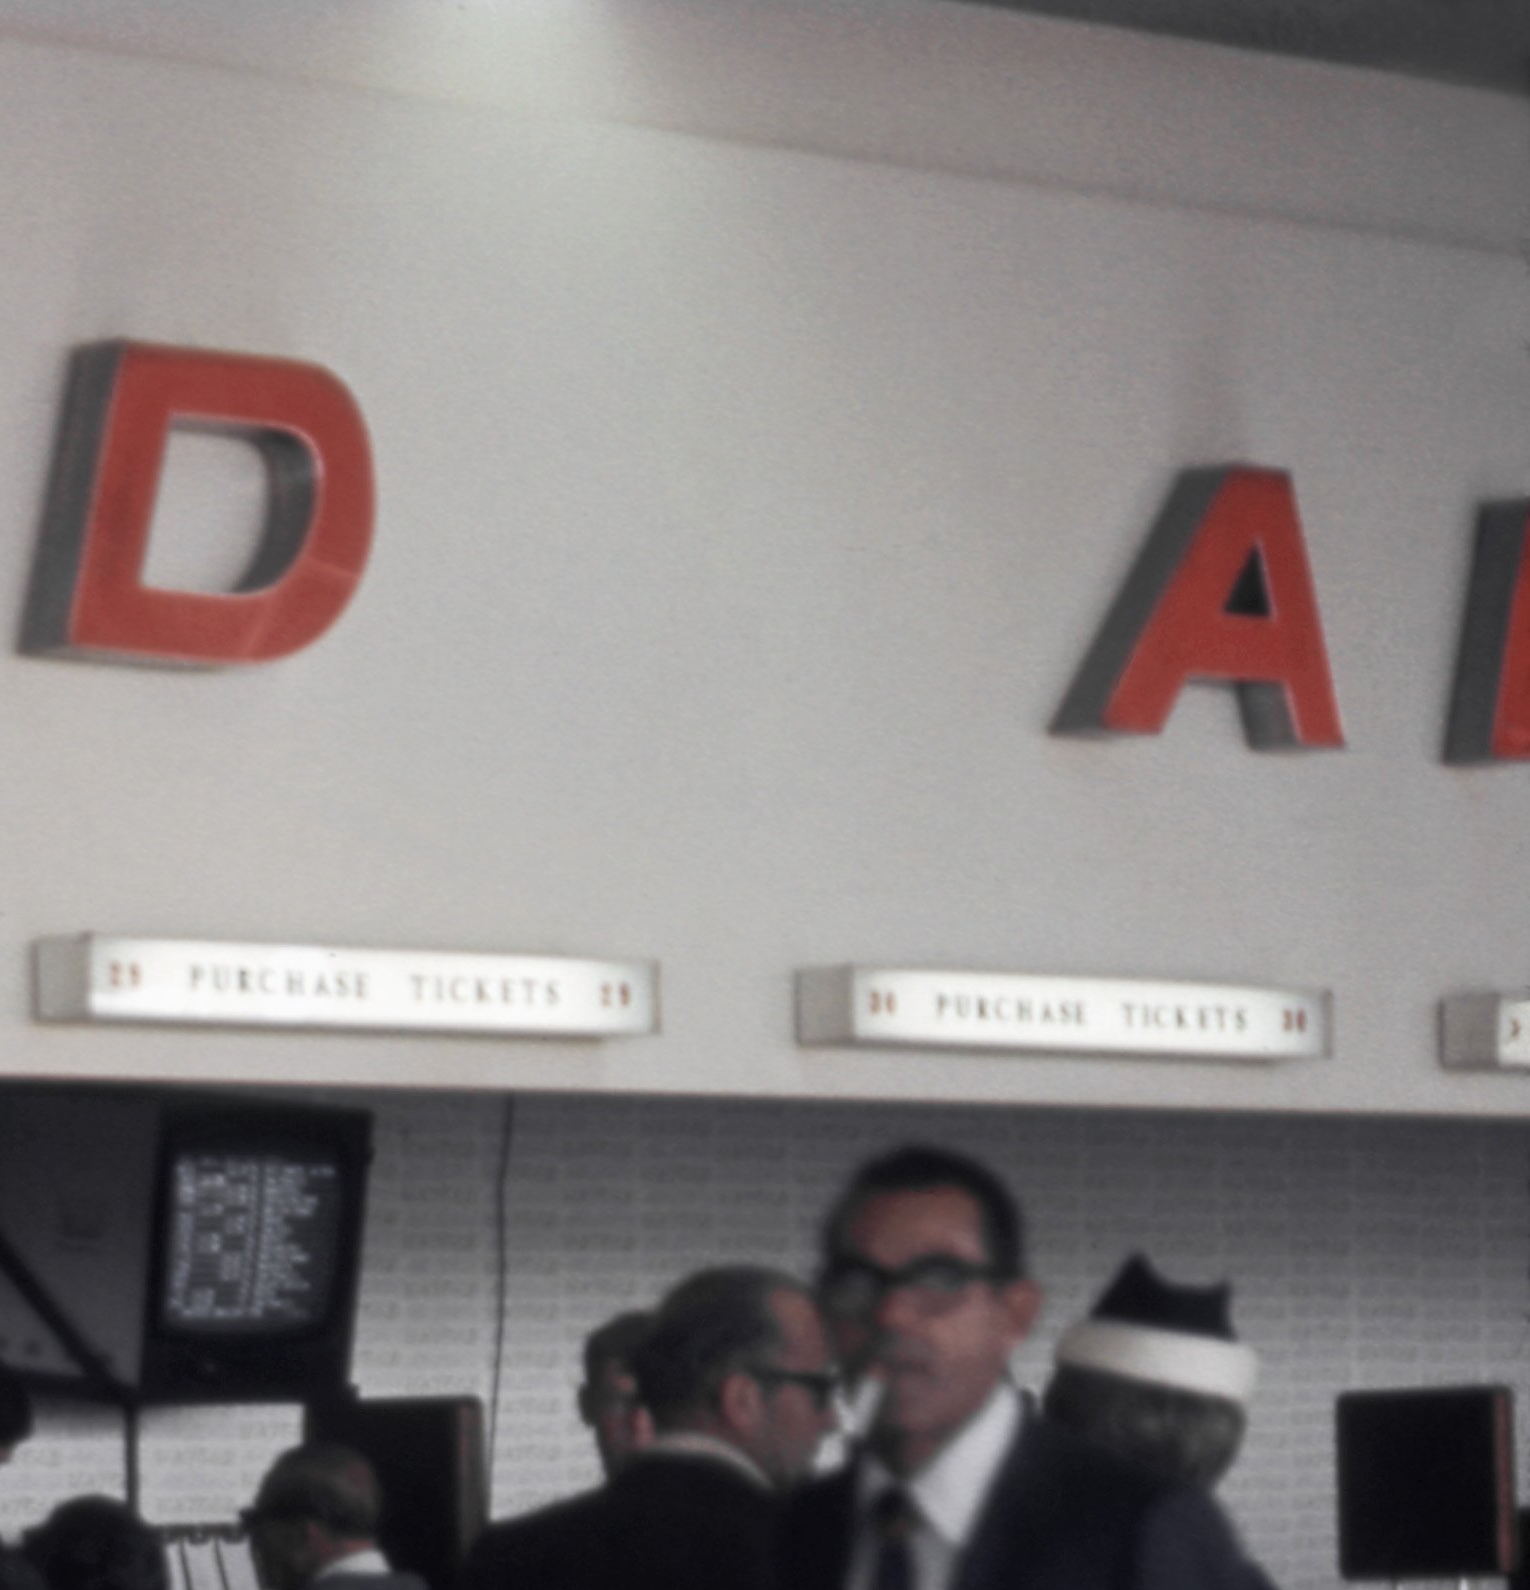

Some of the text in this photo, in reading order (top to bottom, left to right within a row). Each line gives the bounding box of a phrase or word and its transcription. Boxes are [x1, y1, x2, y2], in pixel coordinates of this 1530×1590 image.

[188, 962, 369, 1000] PURCHASE
[409, 972, 560, 1006] TICKETS
[935, 992, 1087, 1028] PURCHASE
[1122, 1001, 1248, 1033] TICKETS
